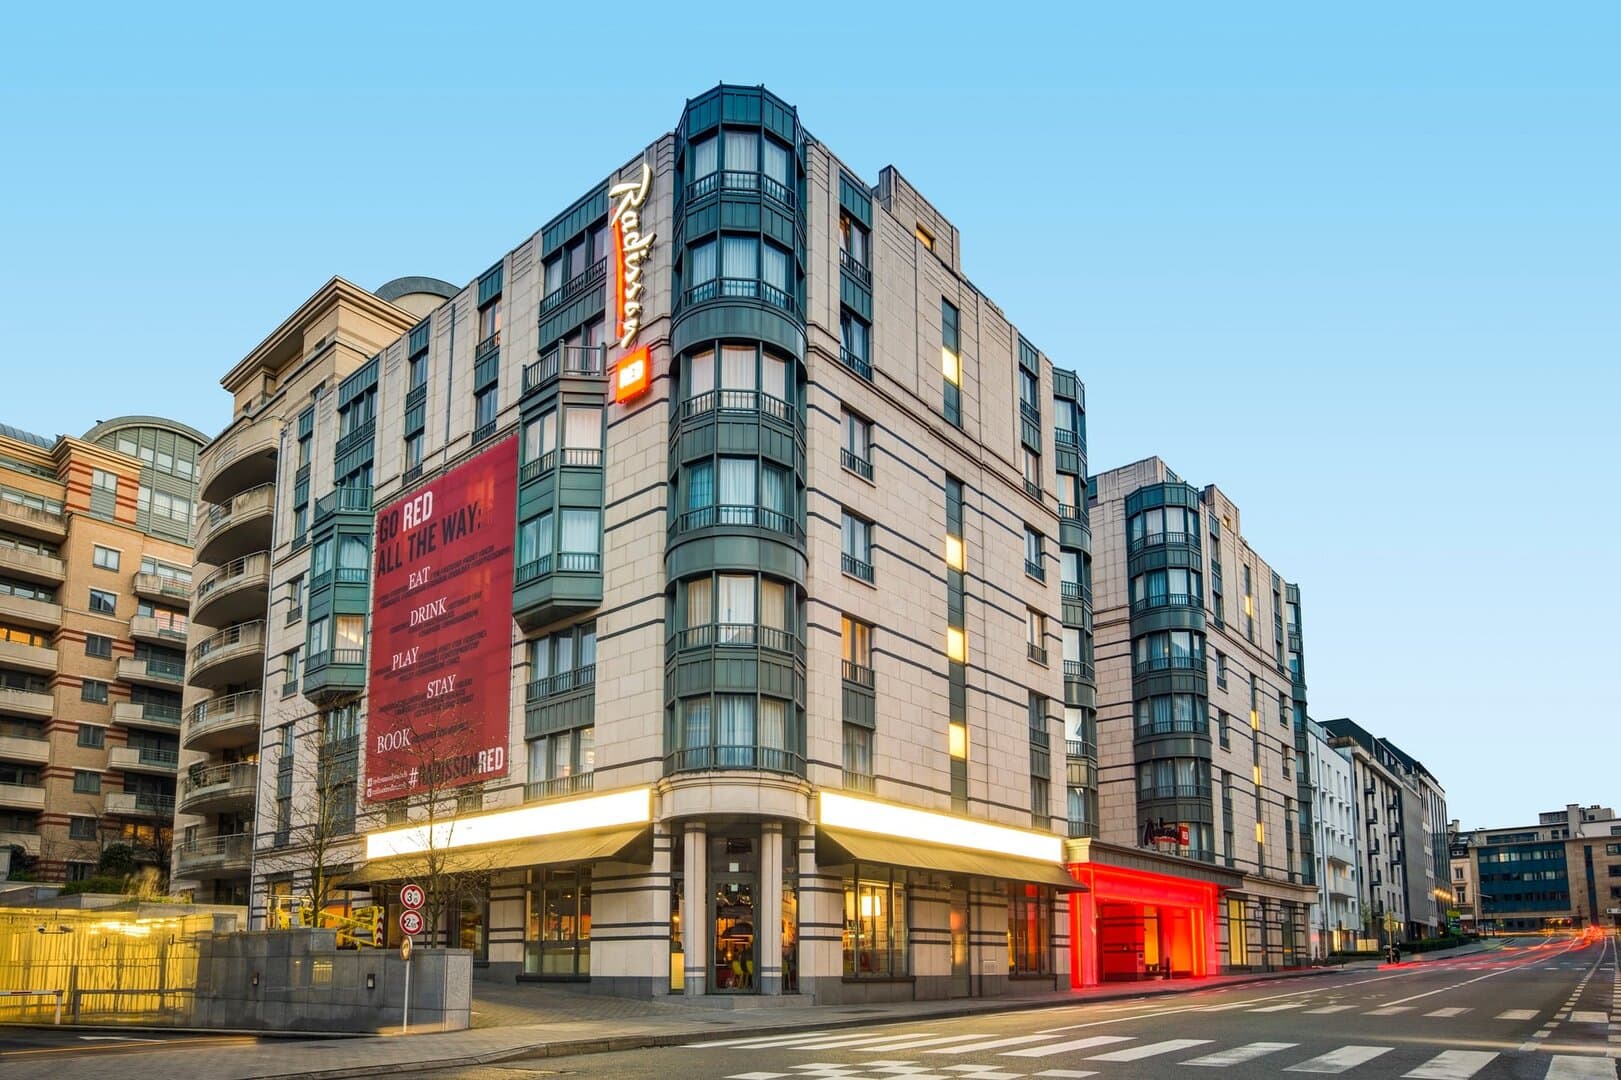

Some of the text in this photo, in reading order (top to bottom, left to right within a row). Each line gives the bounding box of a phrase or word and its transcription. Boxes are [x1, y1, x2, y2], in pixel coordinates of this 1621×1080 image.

[609, 163, 657, 349] Radisson
[379, 491, 433, 544] GO RED
[377, 540, 402, 577] ALL
[408, 522, 438, 562] THE
[408, 566, 431, 590] EAT
[410, 597, 447, 627] DRINK
[391, 646, 420, 671] PLAY
[426, 674, 456, 699] STAY
[377, 728, 411, 753] BOOK
